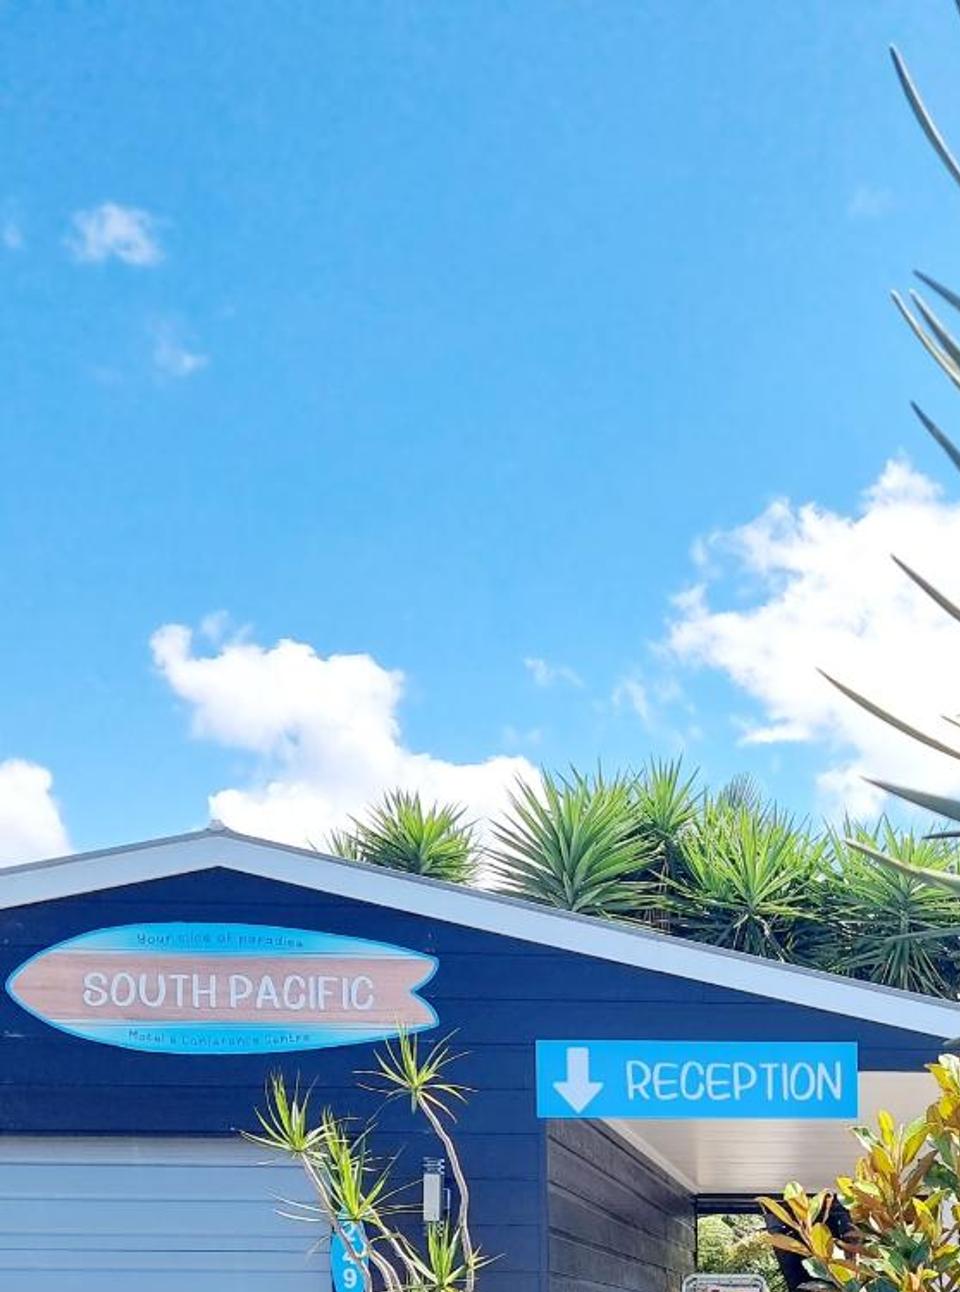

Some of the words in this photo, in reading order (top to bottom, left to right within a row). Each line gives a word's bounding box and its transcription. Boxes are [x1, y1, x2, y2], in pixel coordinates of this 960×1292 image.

[82, 972, 217, 1008] SOUTH
[229, 974, 374, 1010] PACIFIC
[625, 1060, 841, 1100] RECEPTION
